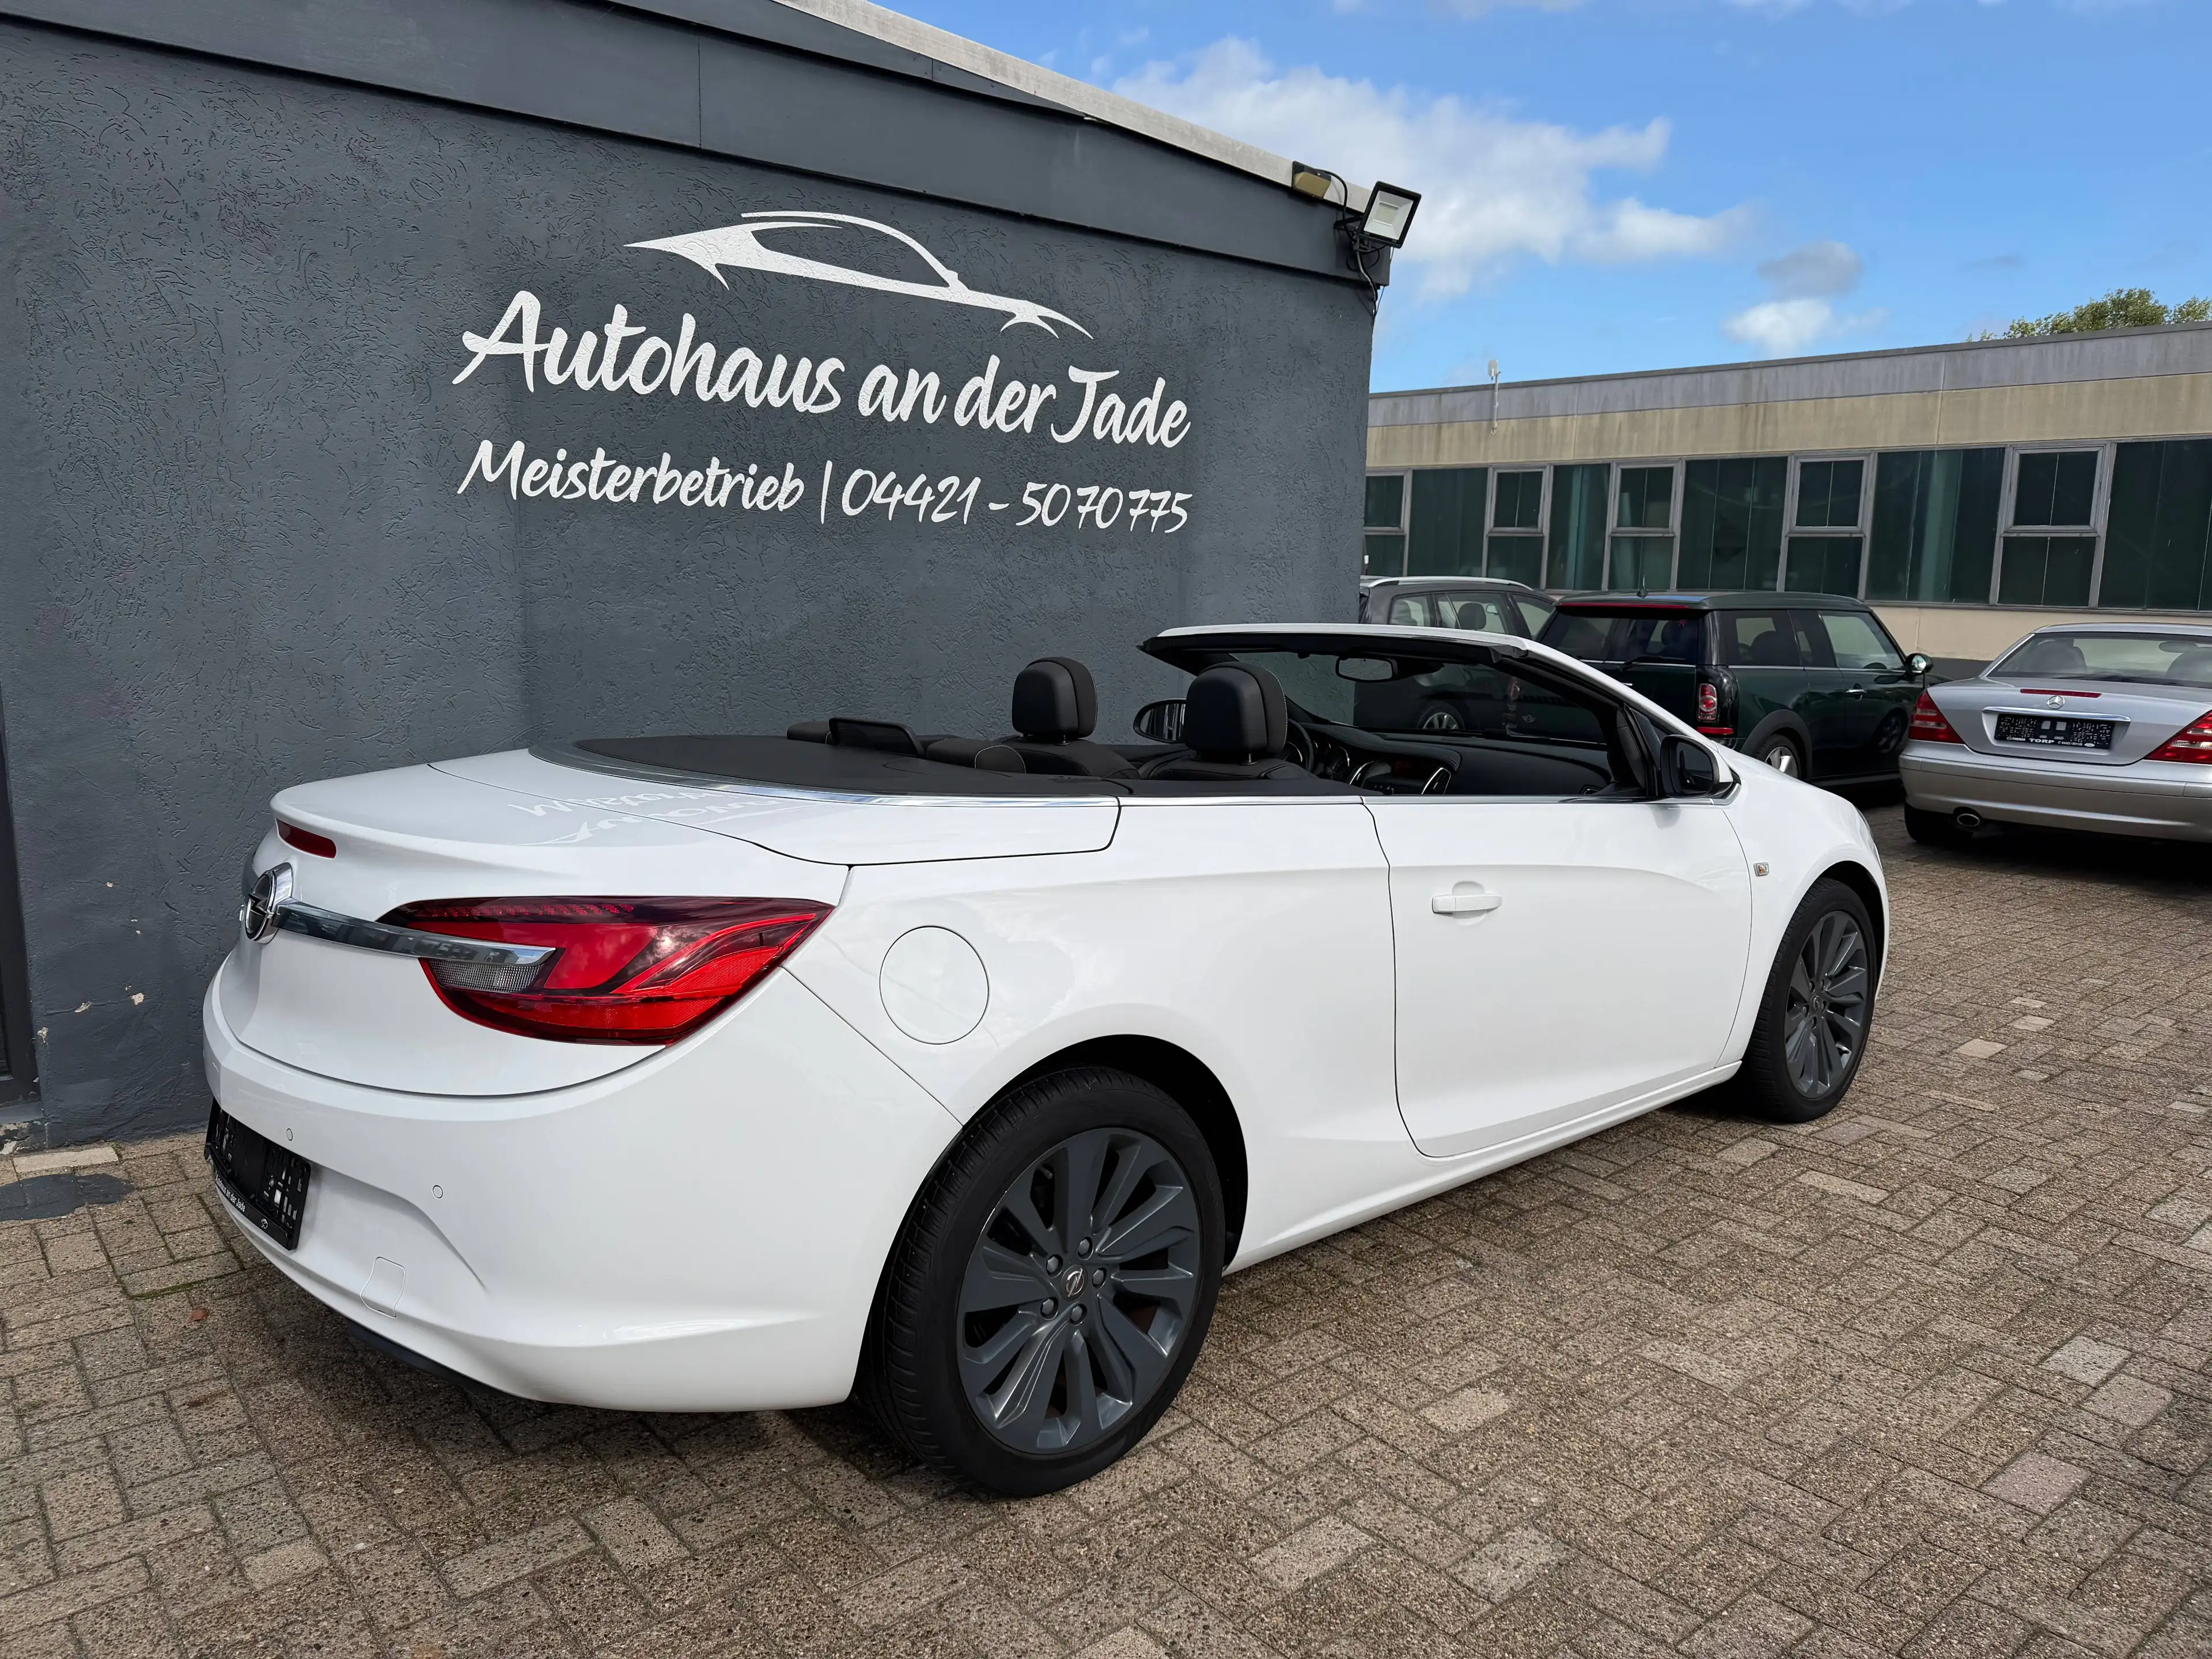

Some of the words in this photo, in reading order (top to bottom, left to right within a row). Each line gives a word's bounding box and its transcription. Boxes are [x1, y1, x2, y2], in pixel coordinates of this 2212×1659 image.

[452, 290, 842, 414] Autohaus
[858, 364, 948, 424] an
[954, 354, 1056, 433] der
[1050, 365, 1192, 448] Jade
[456, 440, 805, 512] Meisterbetrieb
[841, 468, 982, 525] 04421
